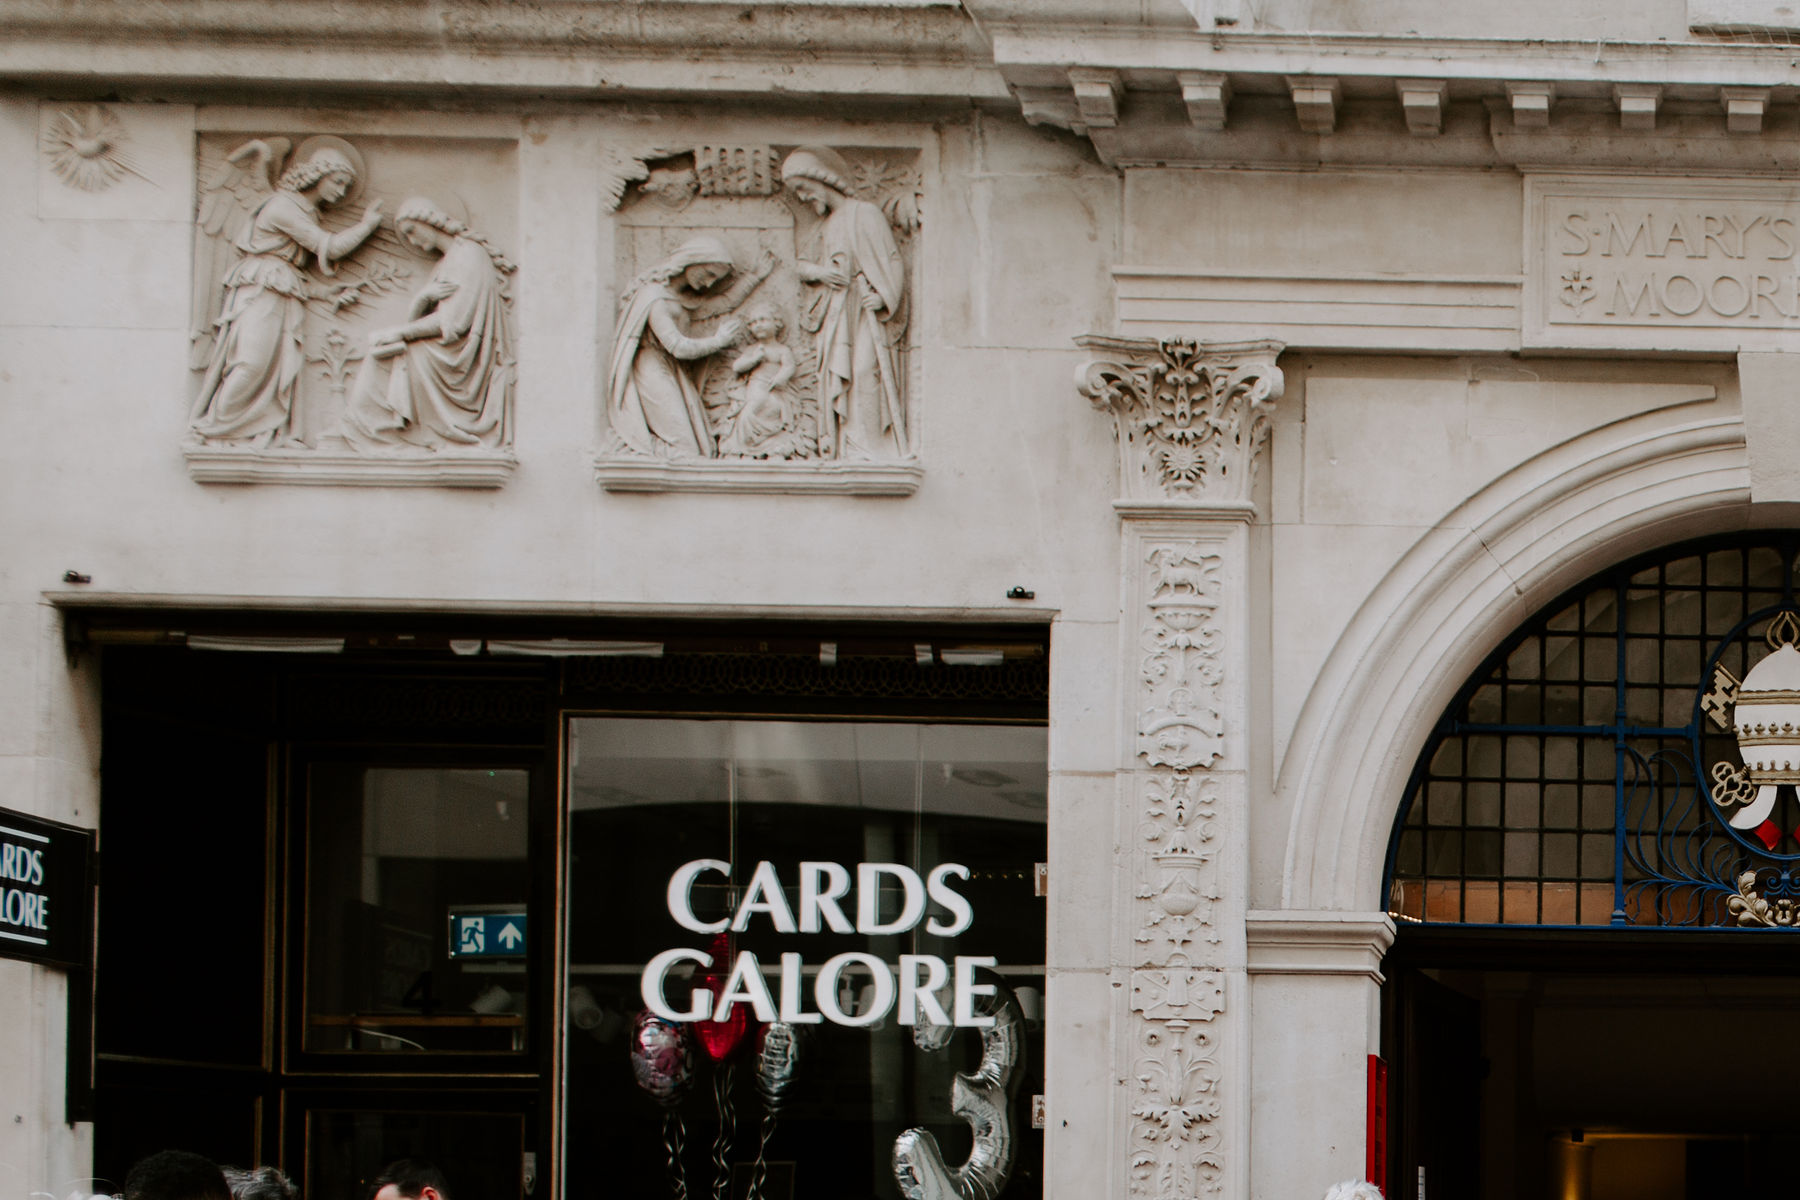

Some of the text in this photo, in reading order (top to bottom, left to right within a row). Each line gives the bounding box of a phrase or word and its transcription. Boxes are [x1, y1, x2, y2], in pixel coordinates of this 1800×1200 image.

[0, 842, 44, 886] RDS
[667, 858, 975, 938] CARDS
[640, 947, 1000, 1028] GALORE
